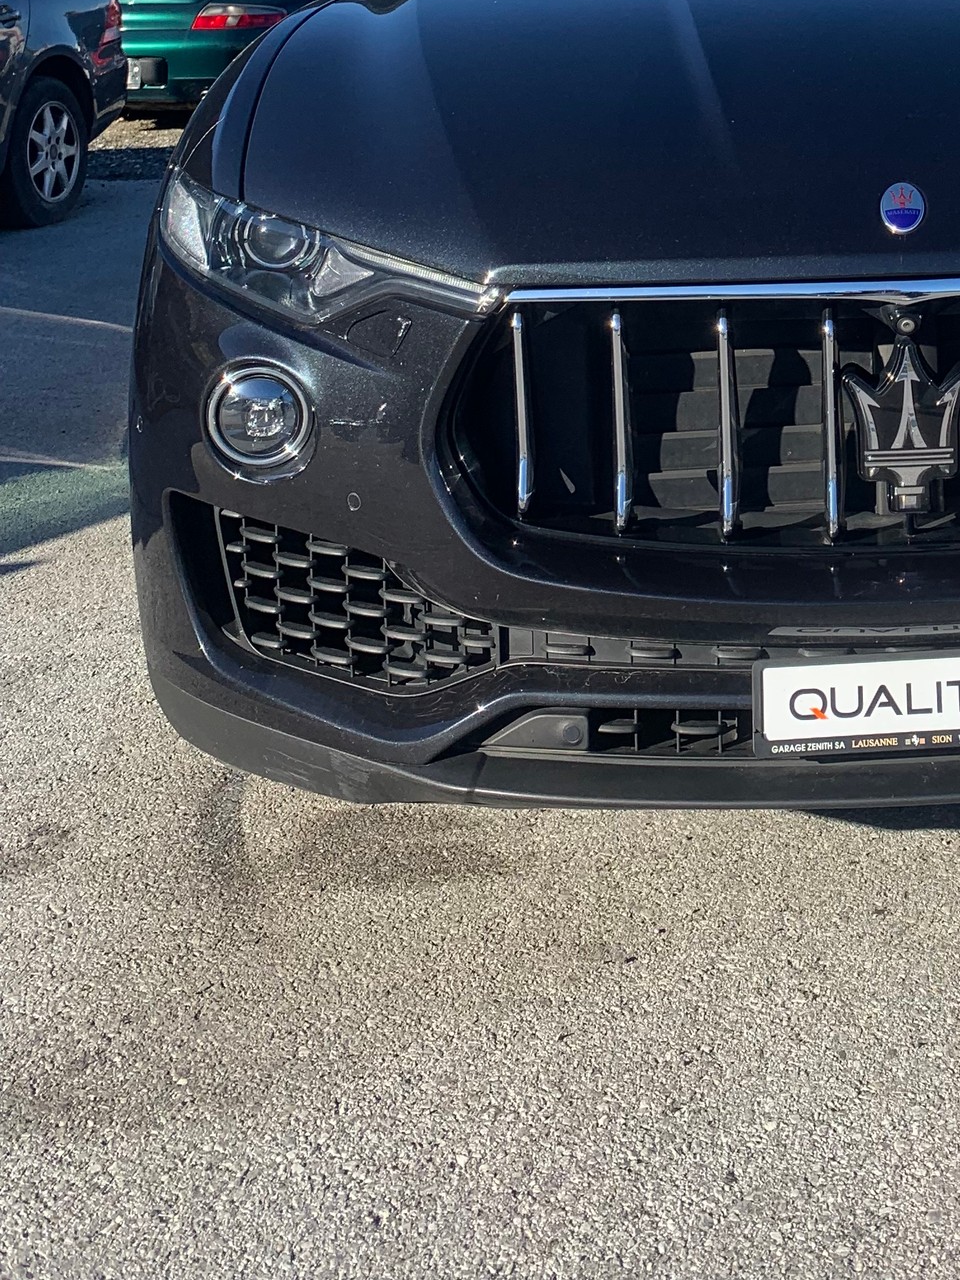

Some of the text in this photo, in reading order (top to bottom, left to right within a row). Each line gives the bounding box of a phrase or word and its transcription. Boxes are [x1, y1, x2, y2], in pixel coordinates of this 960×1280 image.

[771, 744, 806, 754] GARAGE
[806, 741, 833, 752] ZENITH
[834, 740, 845, 750] SA
[851, 737, 898, 748] LAUSANNE
[931, 734, 952, 744] SION
